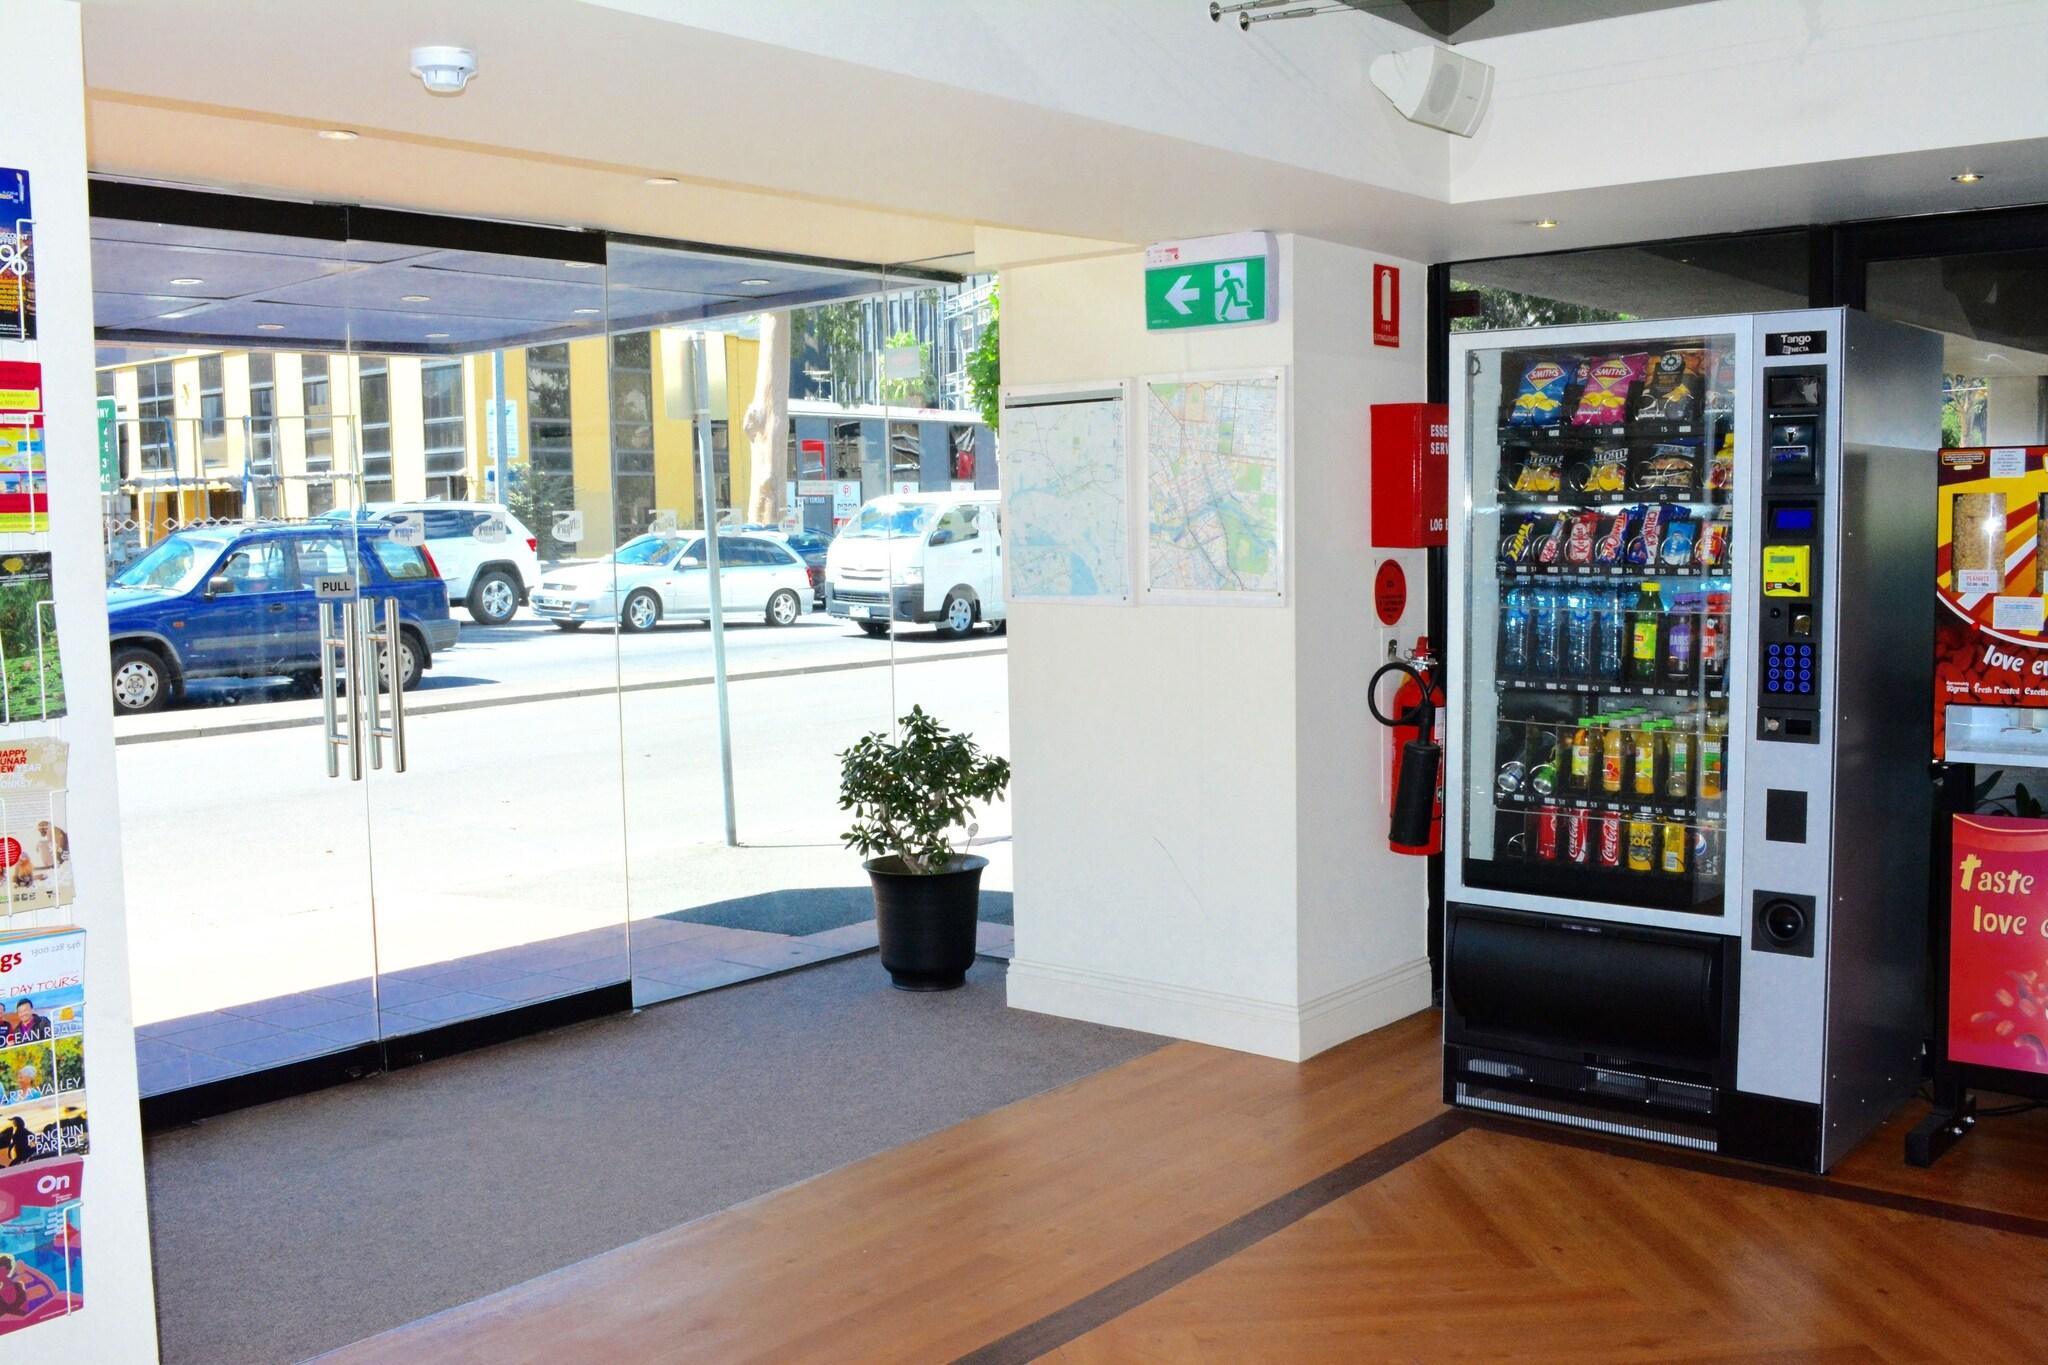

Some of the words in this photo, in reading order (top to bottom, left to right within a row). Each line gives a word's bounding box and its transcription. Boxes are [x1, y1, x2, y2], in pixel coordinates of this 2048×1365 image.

[1780, 334, 1811, 346] Tango
[1530, 368, 1559, 379] SMITHS
[1594, 366, 1627, 376] SMITHS
[1430, 518, 1443, 531] LOG
[322, 581, 351, 592] PULL
[1983, 644, 2024, 672] love
[1960, 853, 2035, 895] taste
[1972, 904, 2028, 936] love
[0, 951, 22, 973] gs
[10, 983, 34, 997] DAY
[37, 975, 80, 991] TOURS
[37, 1076, 81, 1097] VALEY
[27, 1123, 84, 1144] PENGUIN
[35, 1135, 84, 1155] PARADE
[37, 1174, 70, 1194] On
